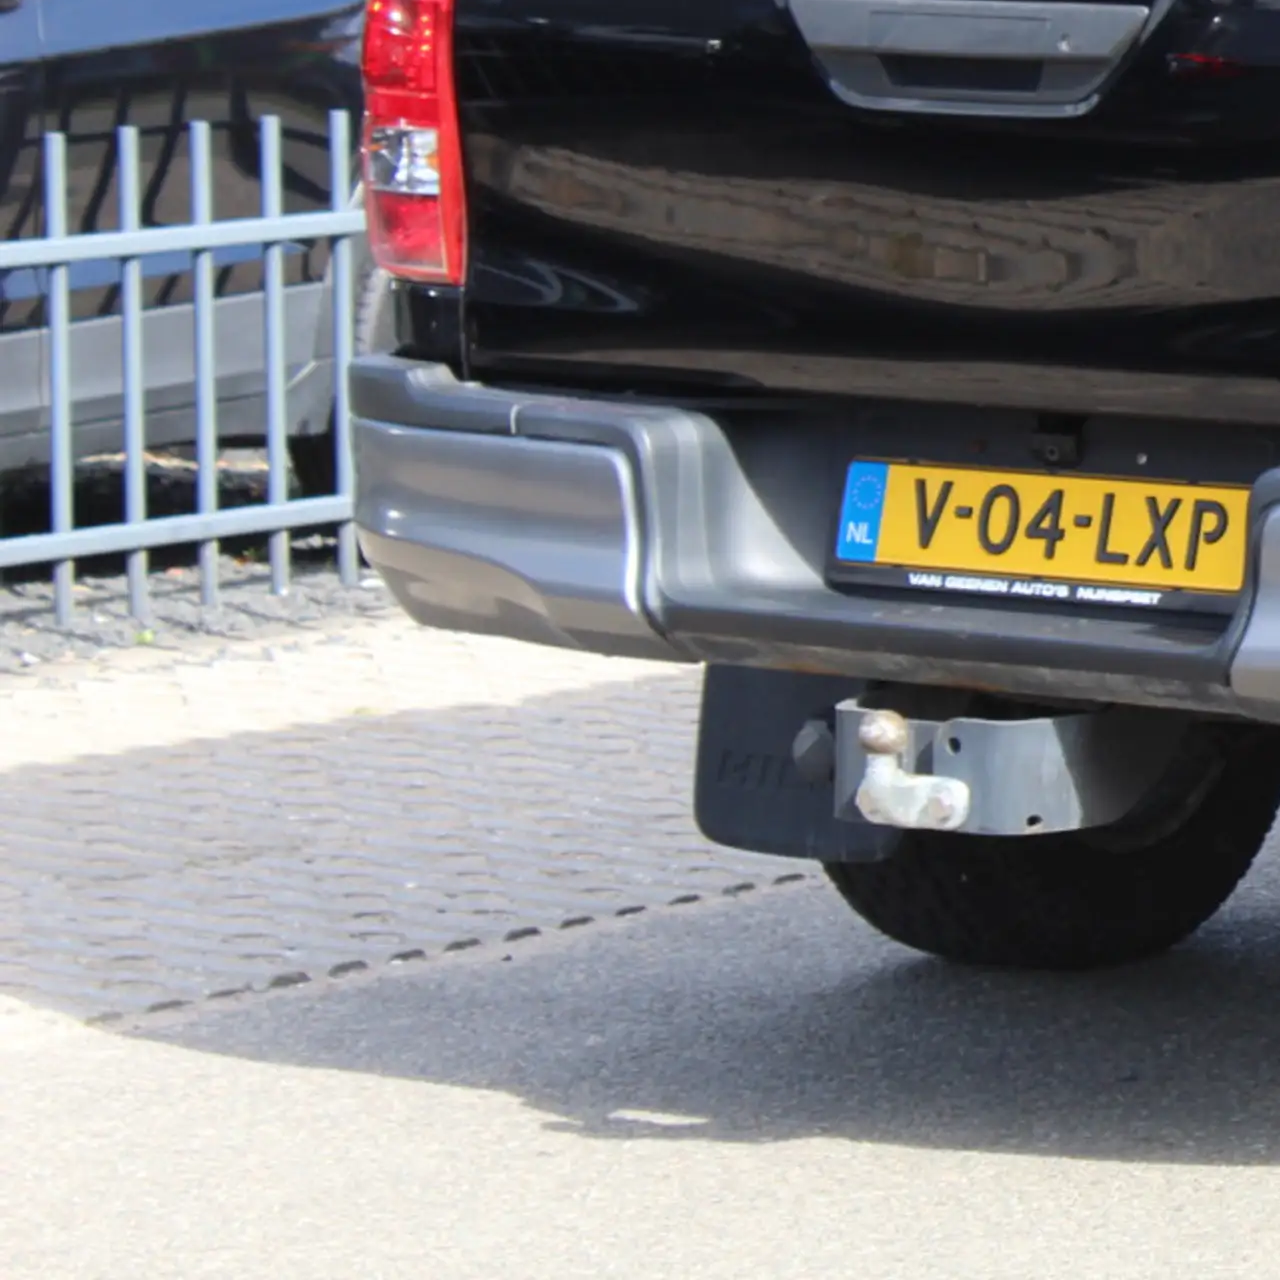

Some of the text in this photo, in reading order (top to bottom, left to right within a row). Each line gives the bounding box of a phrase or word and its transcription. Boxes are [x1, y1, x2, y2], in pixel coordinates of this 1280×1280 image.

[845, 520, 873, 544] NL
[914, 477, 1229, 572] V-04-LXP
[907, 572, 943, 589] VAN
